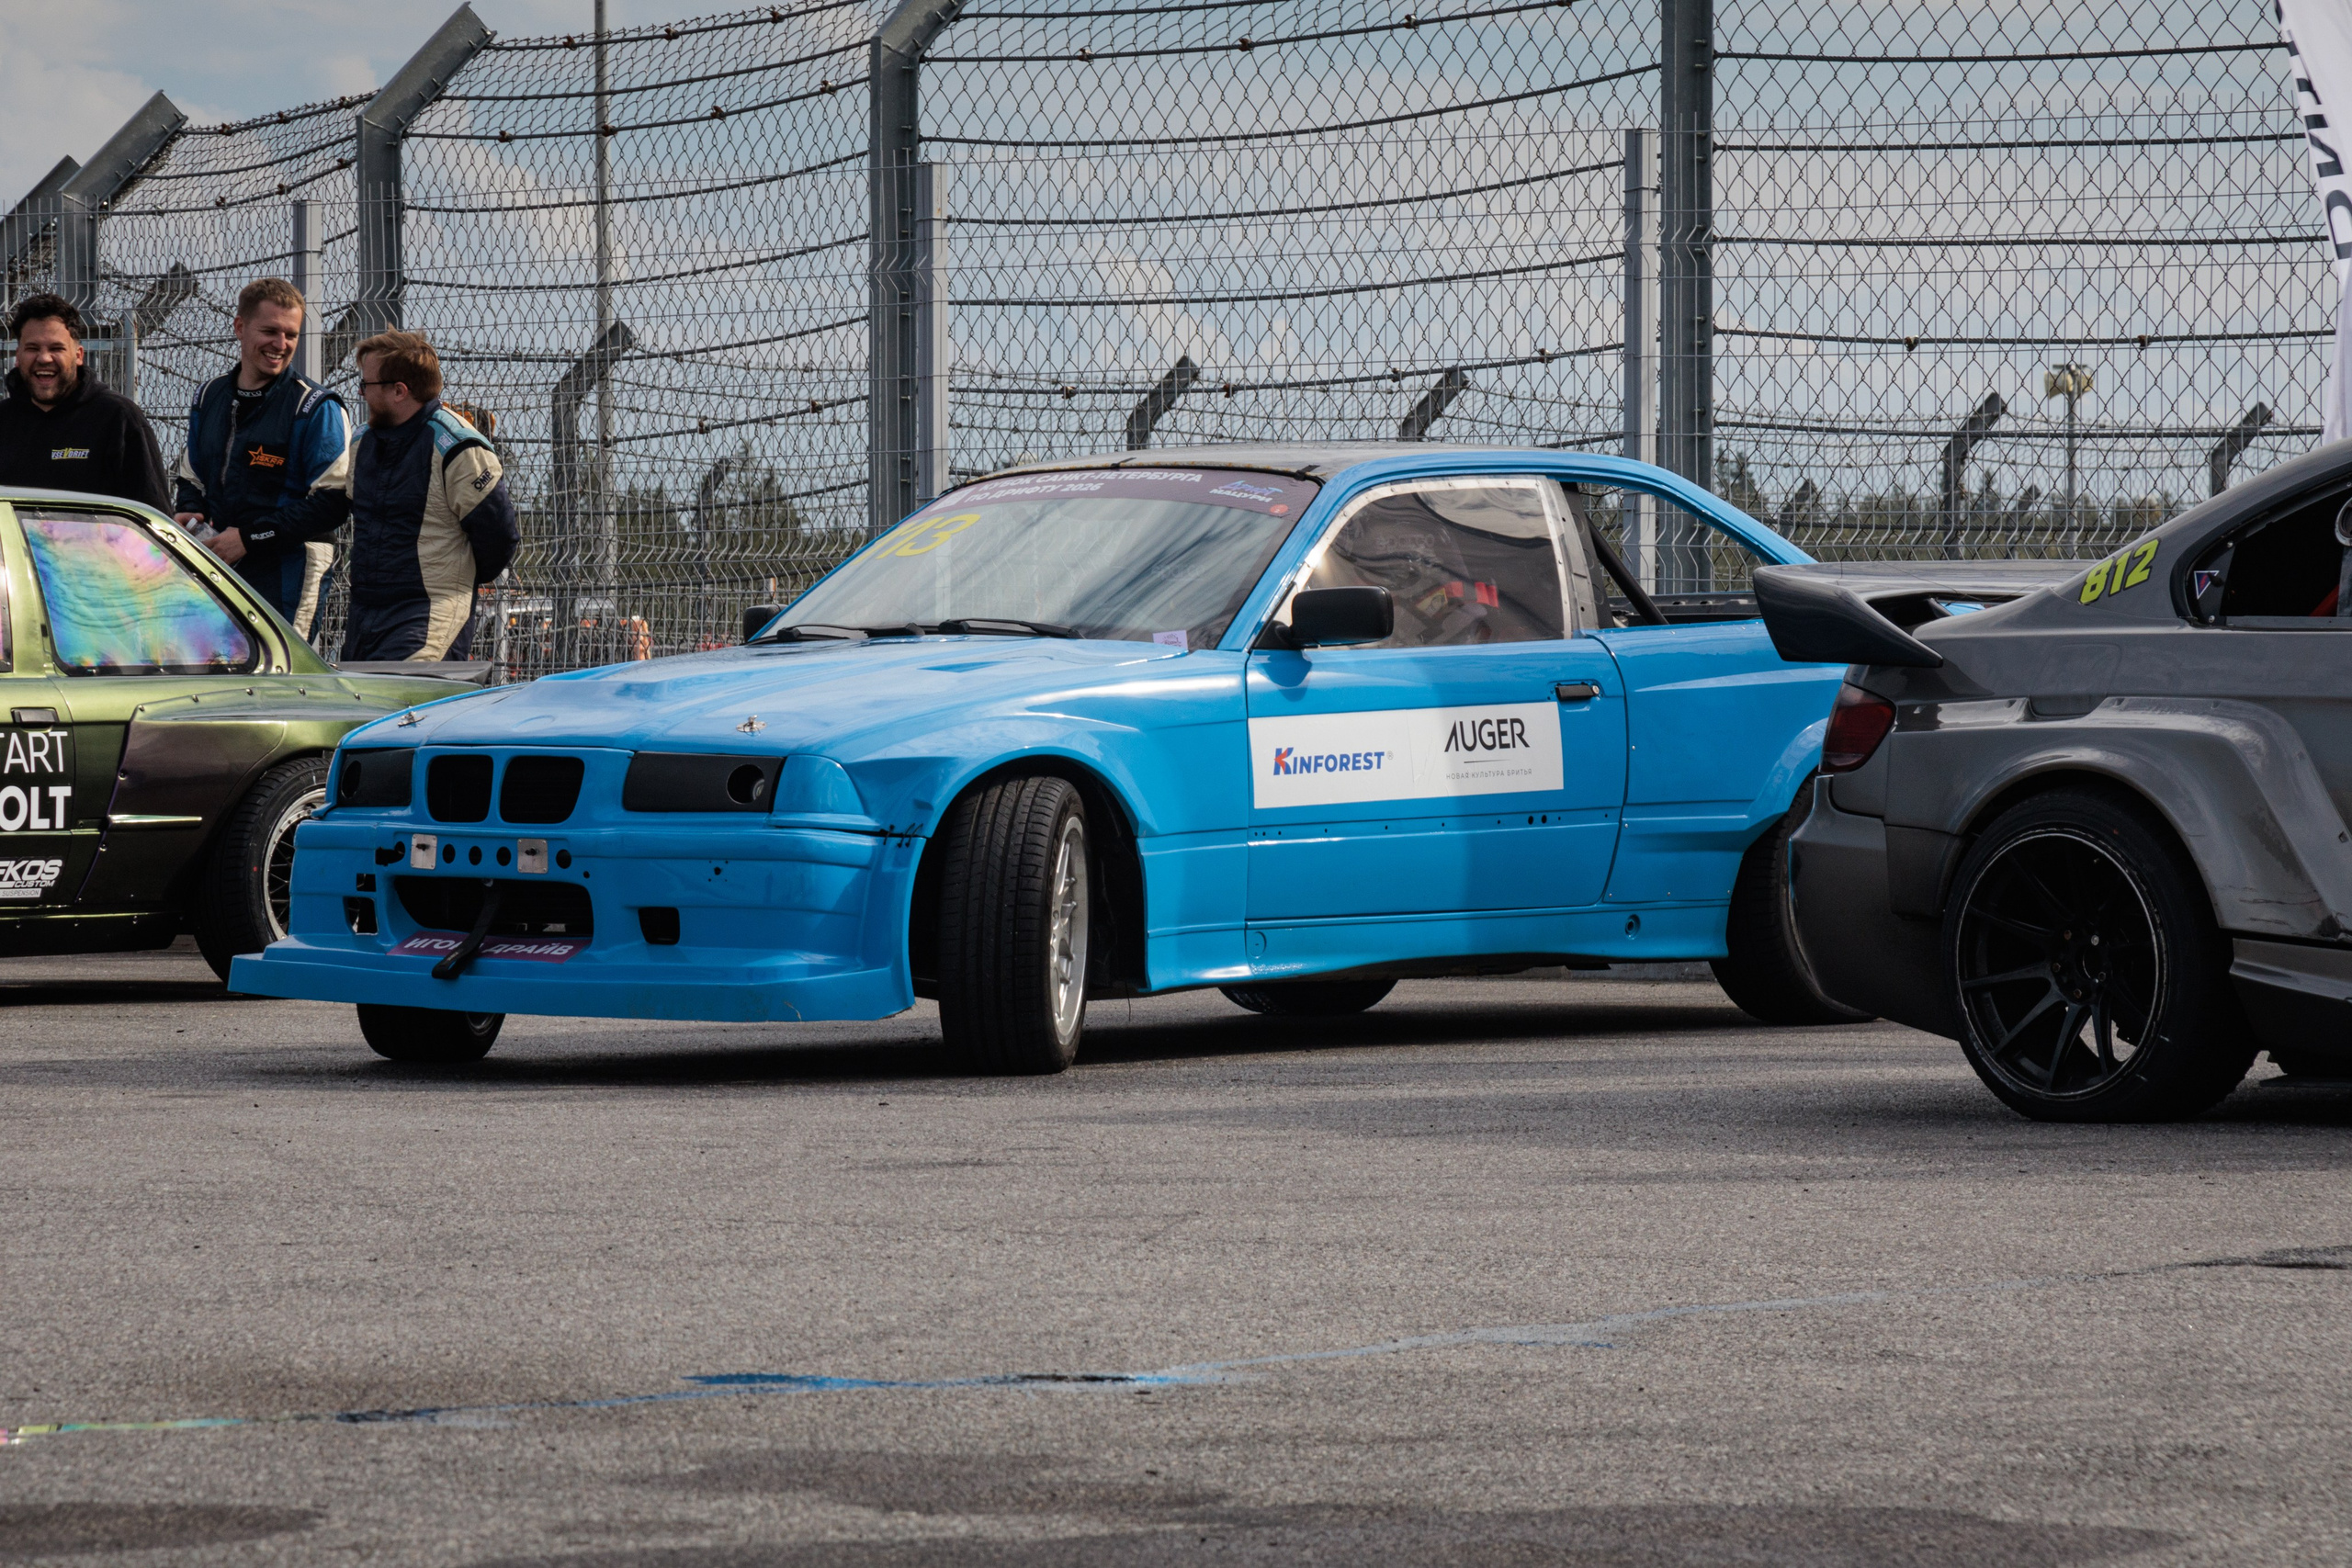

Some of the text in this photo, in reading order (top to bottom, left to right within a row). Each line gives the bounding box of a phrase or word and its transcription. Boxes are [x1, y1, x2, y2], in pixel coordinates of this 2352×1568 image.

[301, 389, 322, 413] sparco
[473, 470, 492, 491] OMP
[978, 471, 1204, 492] КУБОК САНКТ-ПЕТЕРБУРГА
[965, 482, 1105, 503] ПО ДРИФТУ 2026
[1209, 488, 1274, 503] МАЦУРИ
[2078, 538, 2161, 605] 812
[1443, 717, 1531, 752] AUGER
[0, 731, 68, 773] ART
[1273, 747, 1385, 776] KINFOREST
[1445, 768, 1532, 780] НОВАЯ КУЛЬТУРА БРИТЬЯ
[0, 785, 72, 831] OLT
[2, 889, 40, 897] SUSPENSION
[14, 879, 56, 888] CUSTOM
[483, 942, 574, 956] ДРАЙВ
